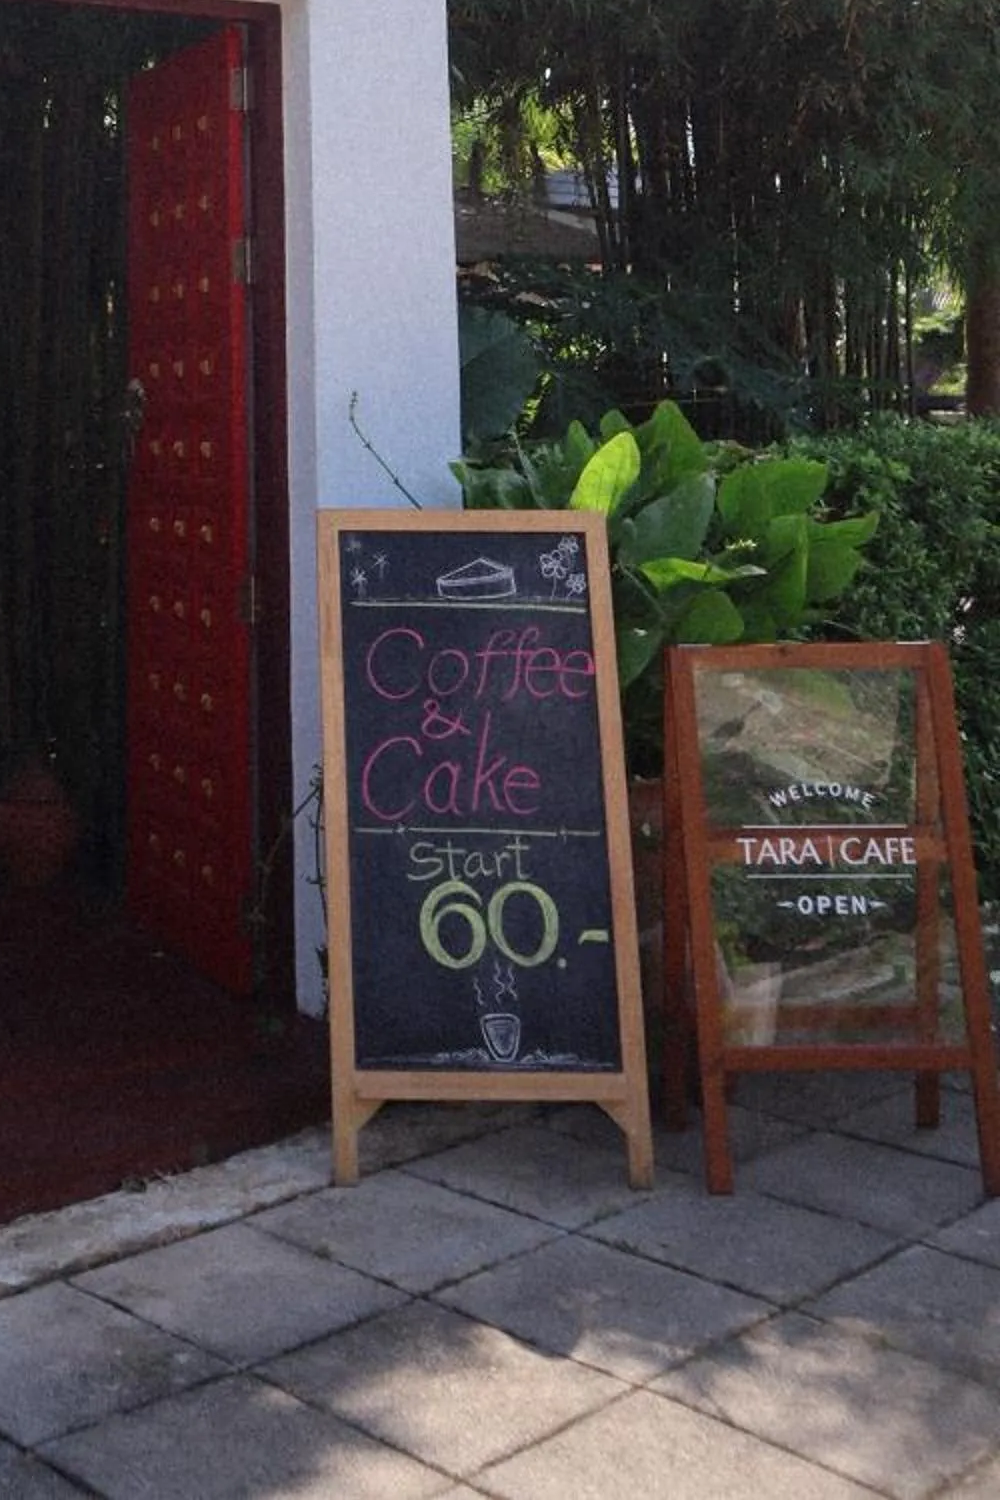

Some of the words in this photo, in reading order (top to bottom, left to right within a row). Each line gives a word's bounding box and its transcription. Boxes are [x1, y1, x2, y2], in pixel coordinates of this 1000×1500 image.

[366, 627, 597, 701] Coffee
[421, 699, 472, 739] &
[361, 710, 541, 821] Cake
[769, 782, 876, 812] WELCOME
[407, 836, 531, 881] Start
[736, 837, 823, 865] TARA
[839, 837, 917, 865] CAFE
[797, 895, 868, 915] OPEN
